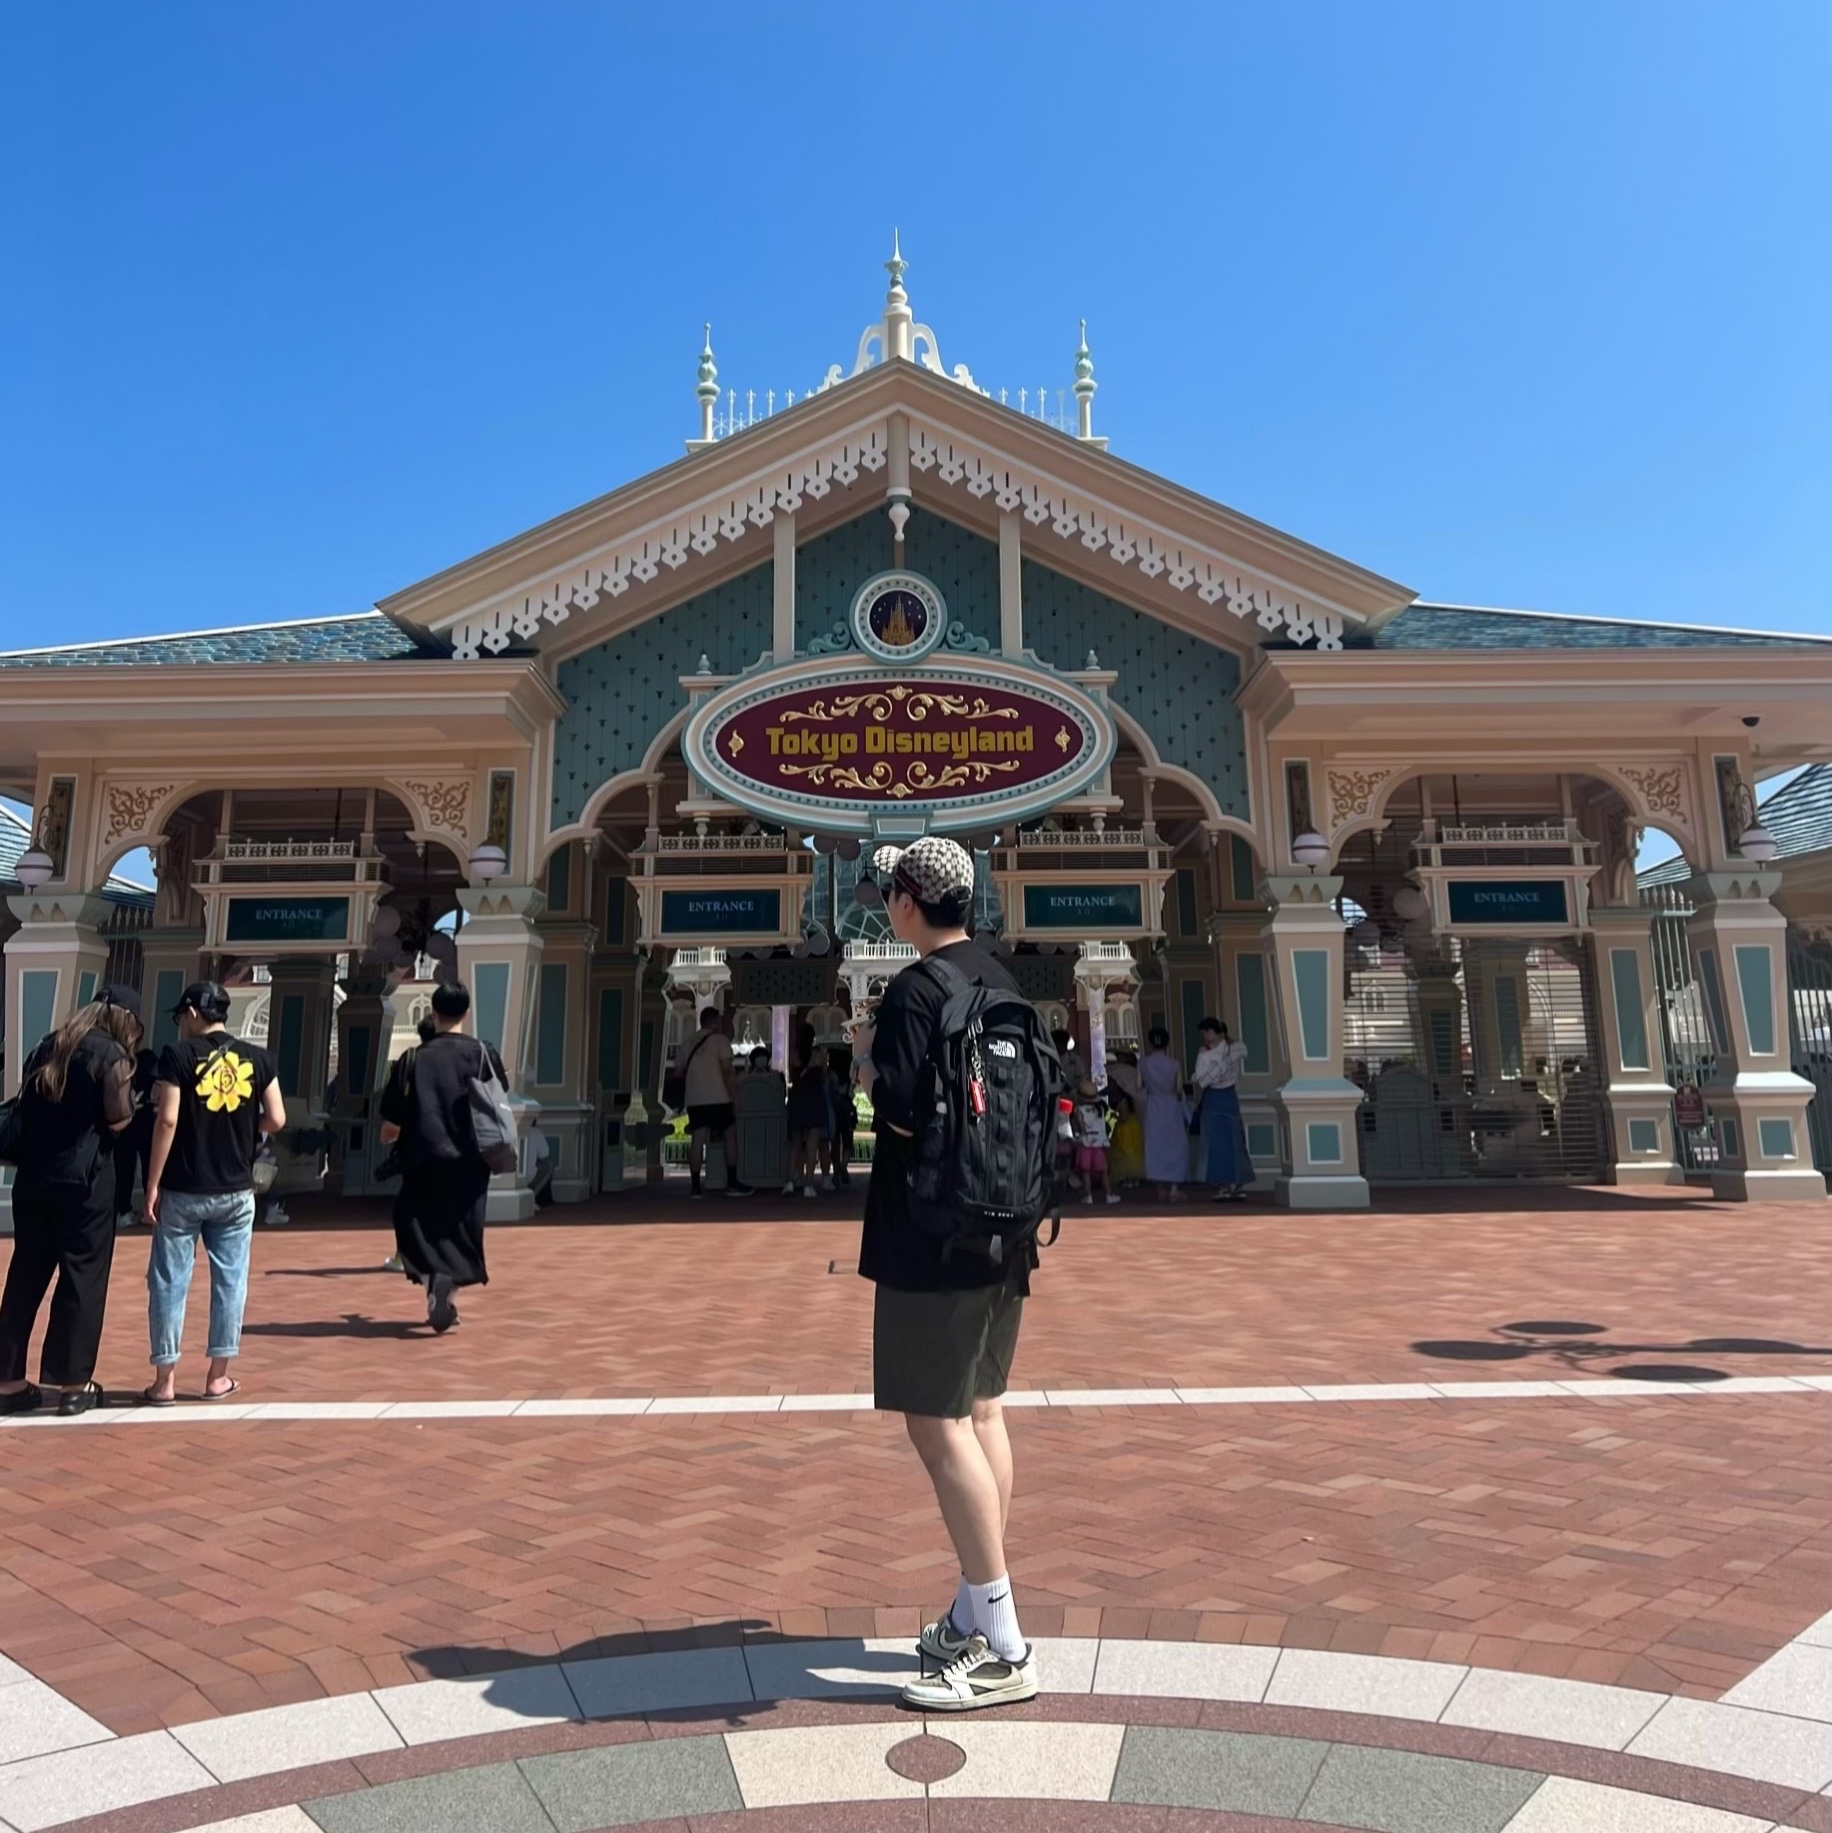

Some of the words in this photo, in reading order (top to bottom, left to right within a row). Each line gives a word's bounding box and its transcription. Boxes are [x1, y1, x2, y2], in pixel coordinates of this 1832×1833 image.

[765, 727, 858, 761] Tokyo
[865, 725, 1034, 760] Disneyland
[1050, 896, 1115, 907] ENTRANCE
[1473, 892, 1540, 903] ENTRANCE
[688, 901, 754, 912] ENTRANCE
[256, 909, 322, 920] ENTRANCE
